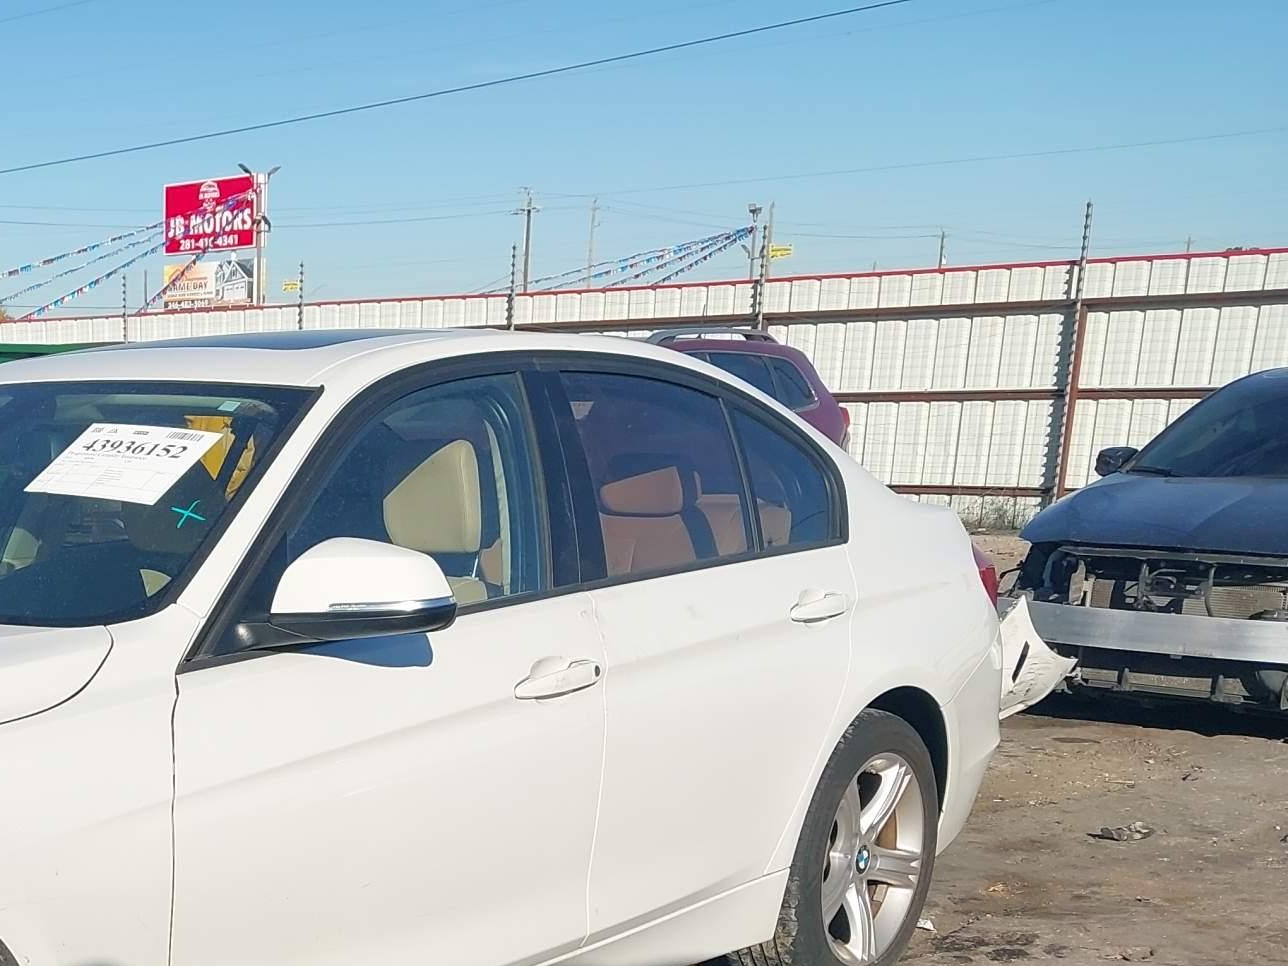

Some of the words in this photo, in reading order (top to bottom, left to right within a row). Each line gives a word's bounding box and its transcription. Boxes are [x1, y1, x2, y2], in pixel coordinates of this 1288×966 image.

[190, 208, 252, 235] MOTORS
[193, 280, 209, 290] DAY
[82, 438, 188, 459] 43936152
